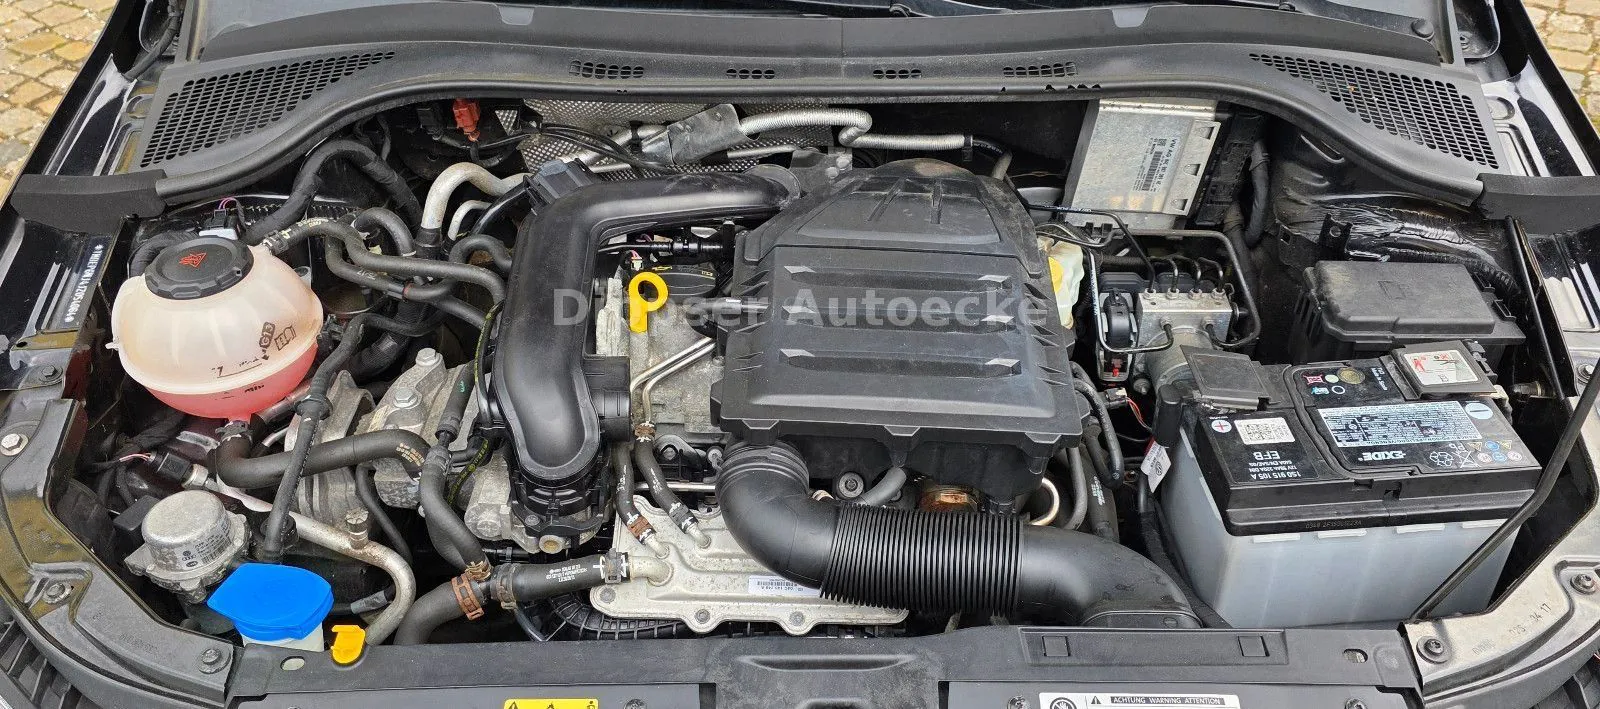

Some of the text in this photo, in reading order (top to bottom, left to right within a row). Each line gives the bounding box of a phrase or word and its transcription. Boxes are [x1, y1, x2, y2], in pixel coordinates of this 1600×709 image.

[1448, 443, 1467, 453] Pb
[1252, 450, 1281, 460] EFB
[1361, 450, 1406, 461] EXIDE
[1257, 472, 1272, 480] 105
[1272, 471, 1287, 479] 915
[1113, 696, 1146, 704] ACHTUNG
[1184, 697, 1221, 705] ATTENTION
